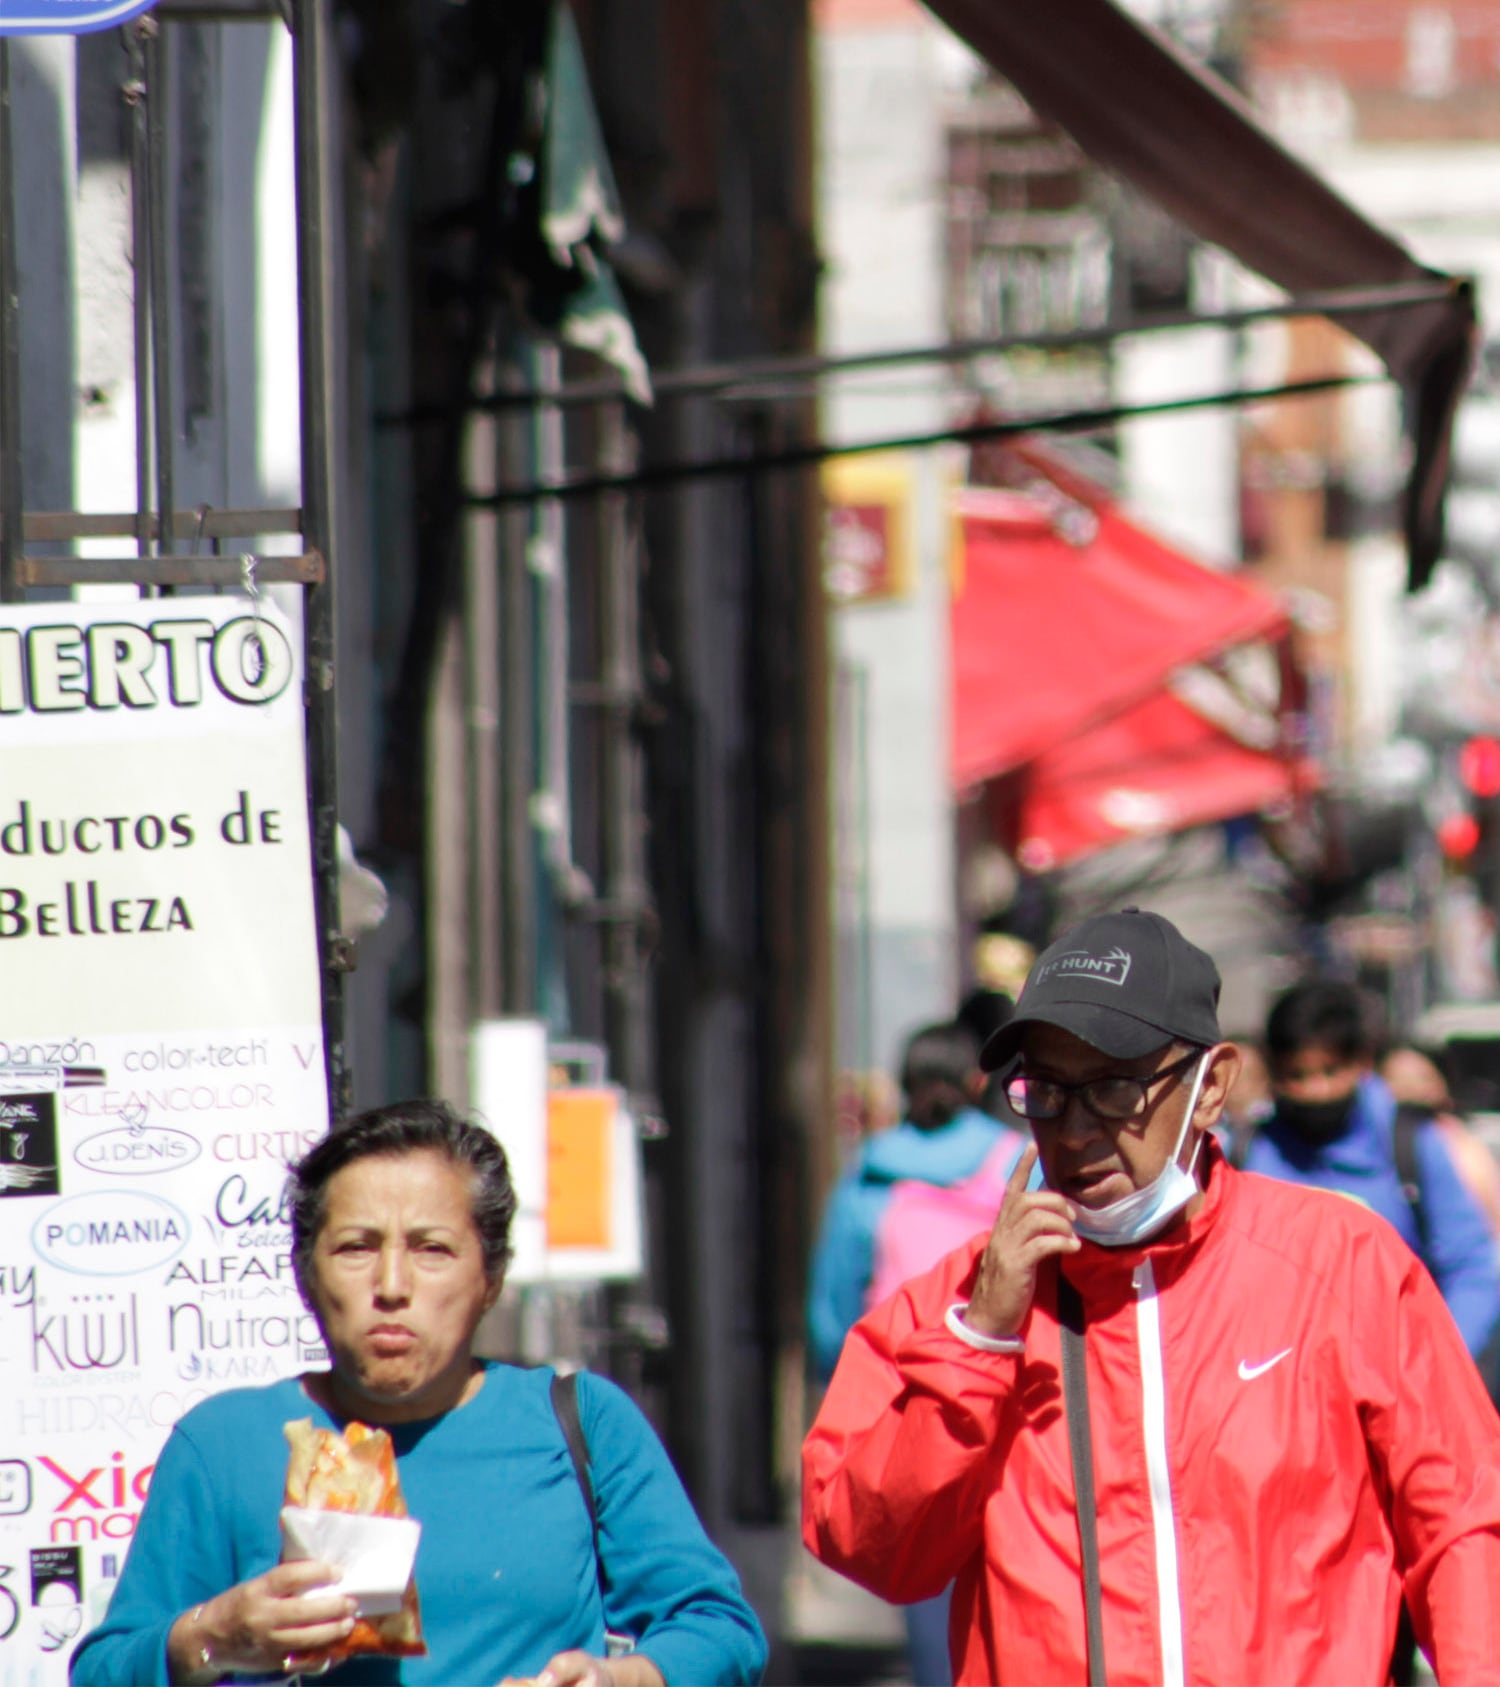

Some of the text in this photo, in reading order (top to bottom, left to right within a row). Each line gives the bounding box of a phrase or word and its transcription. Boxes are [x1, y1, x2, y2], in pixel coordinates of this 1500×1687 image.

[1062, 958, 1116, 974] HUNT
[62, 1084, 275, 1116] KLEANCOLOR
[47, 1218, 181, 1248] POMANIA
